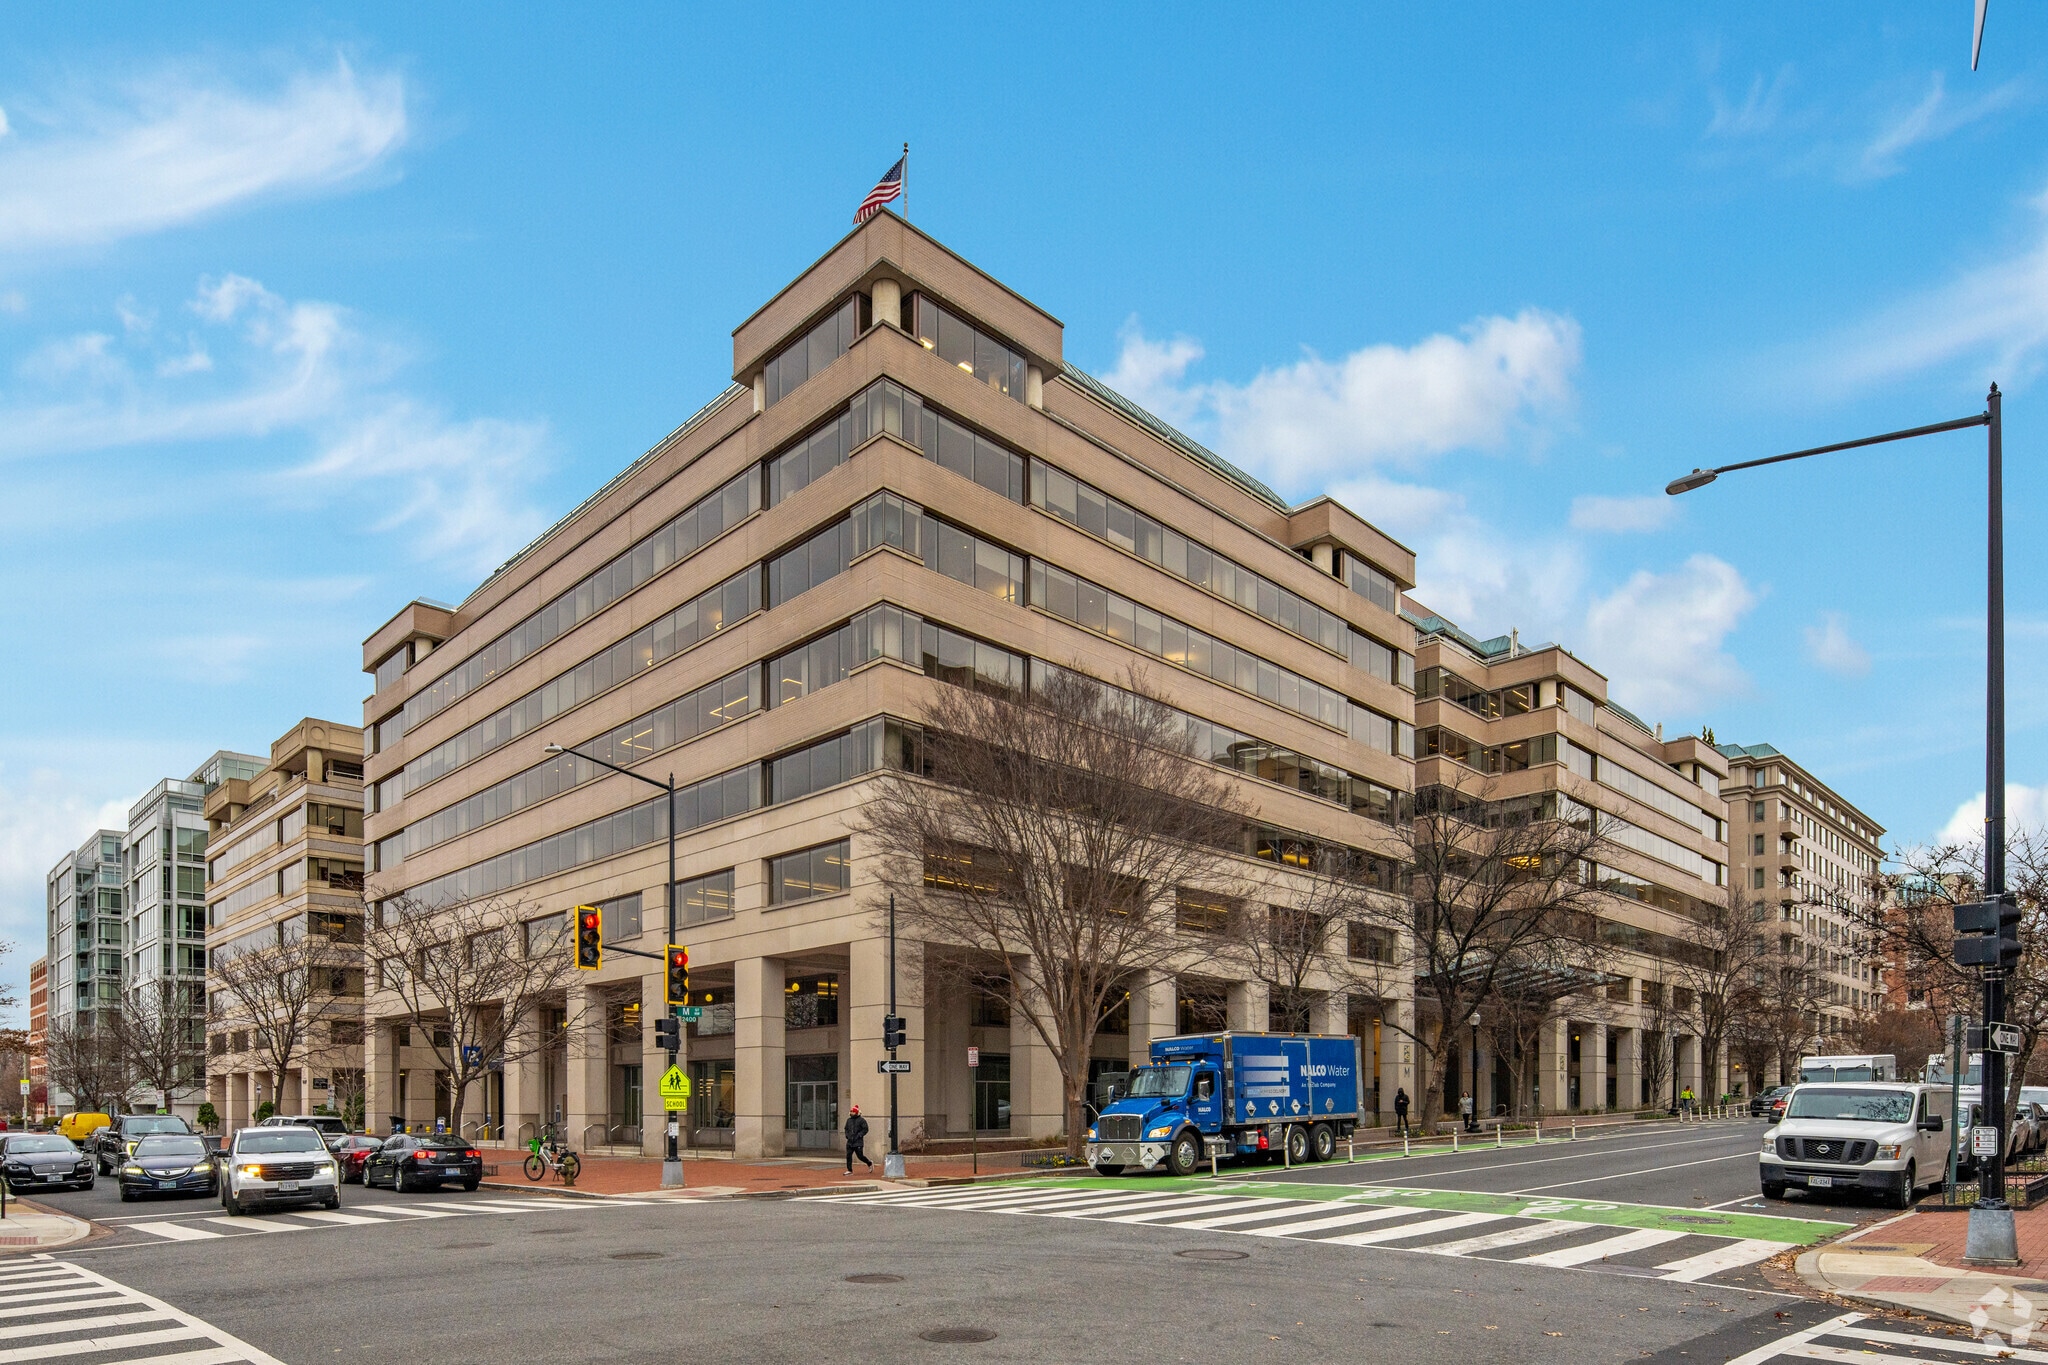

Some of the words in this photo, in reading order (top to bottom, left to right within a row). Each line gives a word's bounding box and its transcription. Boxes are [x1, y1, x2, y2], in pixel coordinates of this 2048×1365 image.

[2000, 1032, 2009, 1044] ONE
[2010, 1034, 2018, 1045] WAY
[1300, 1065, 1327, 1077] NALCO
[1327, 1065, 1350, 1076] Water
